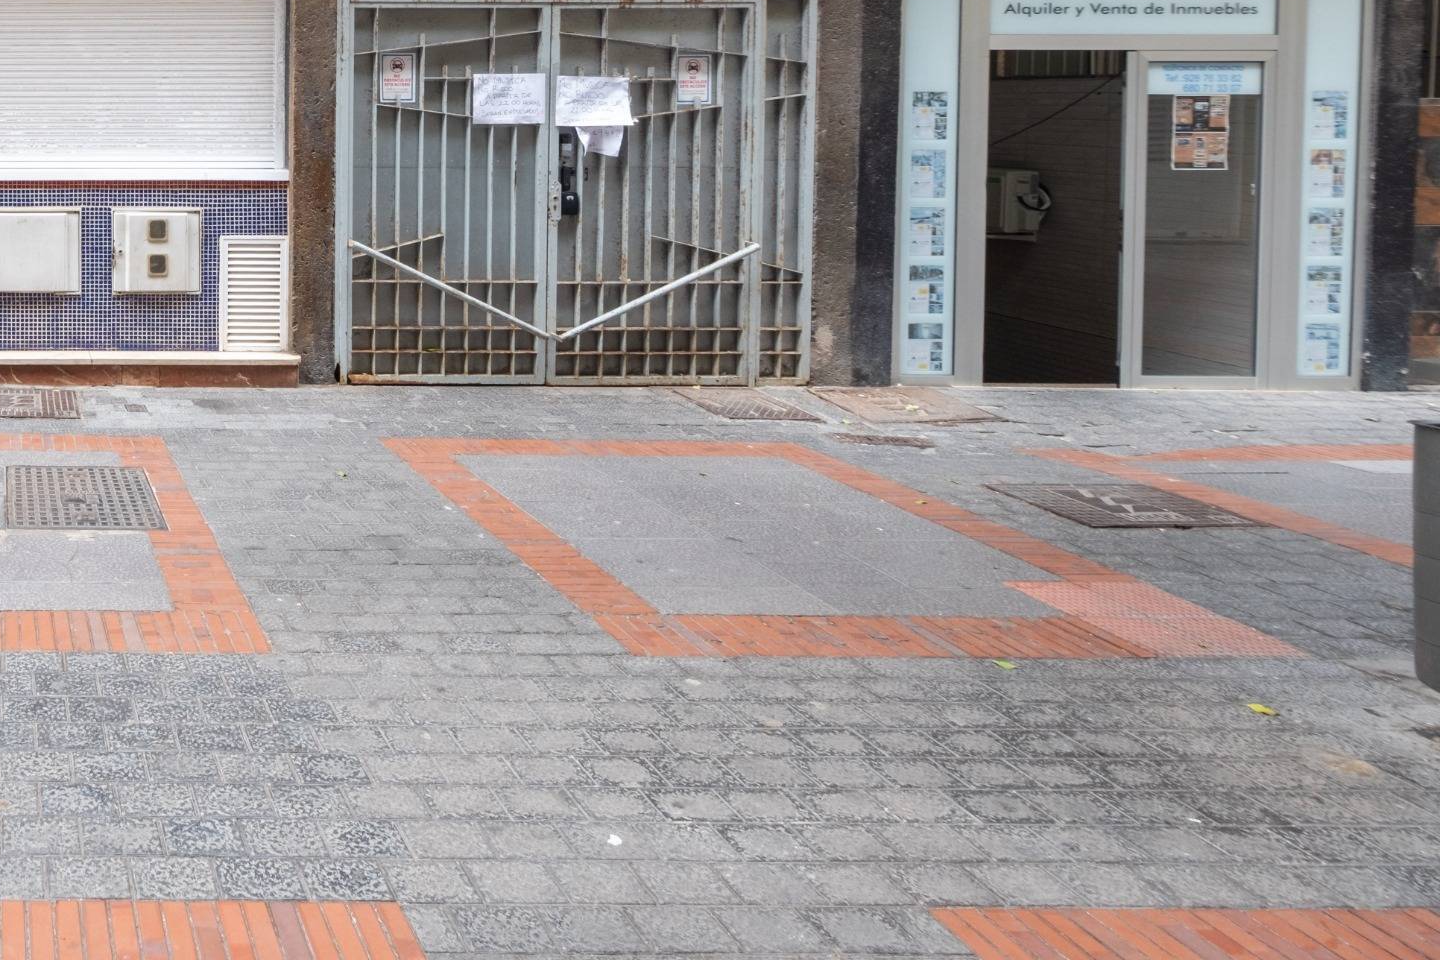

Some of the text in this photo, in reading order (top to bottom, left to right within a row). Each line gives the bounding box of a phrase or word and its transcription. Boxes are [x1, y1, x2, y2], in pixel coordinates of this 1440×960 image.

[1003, 1, 1259, 16] Alquiler y Venta de Inmuebles
